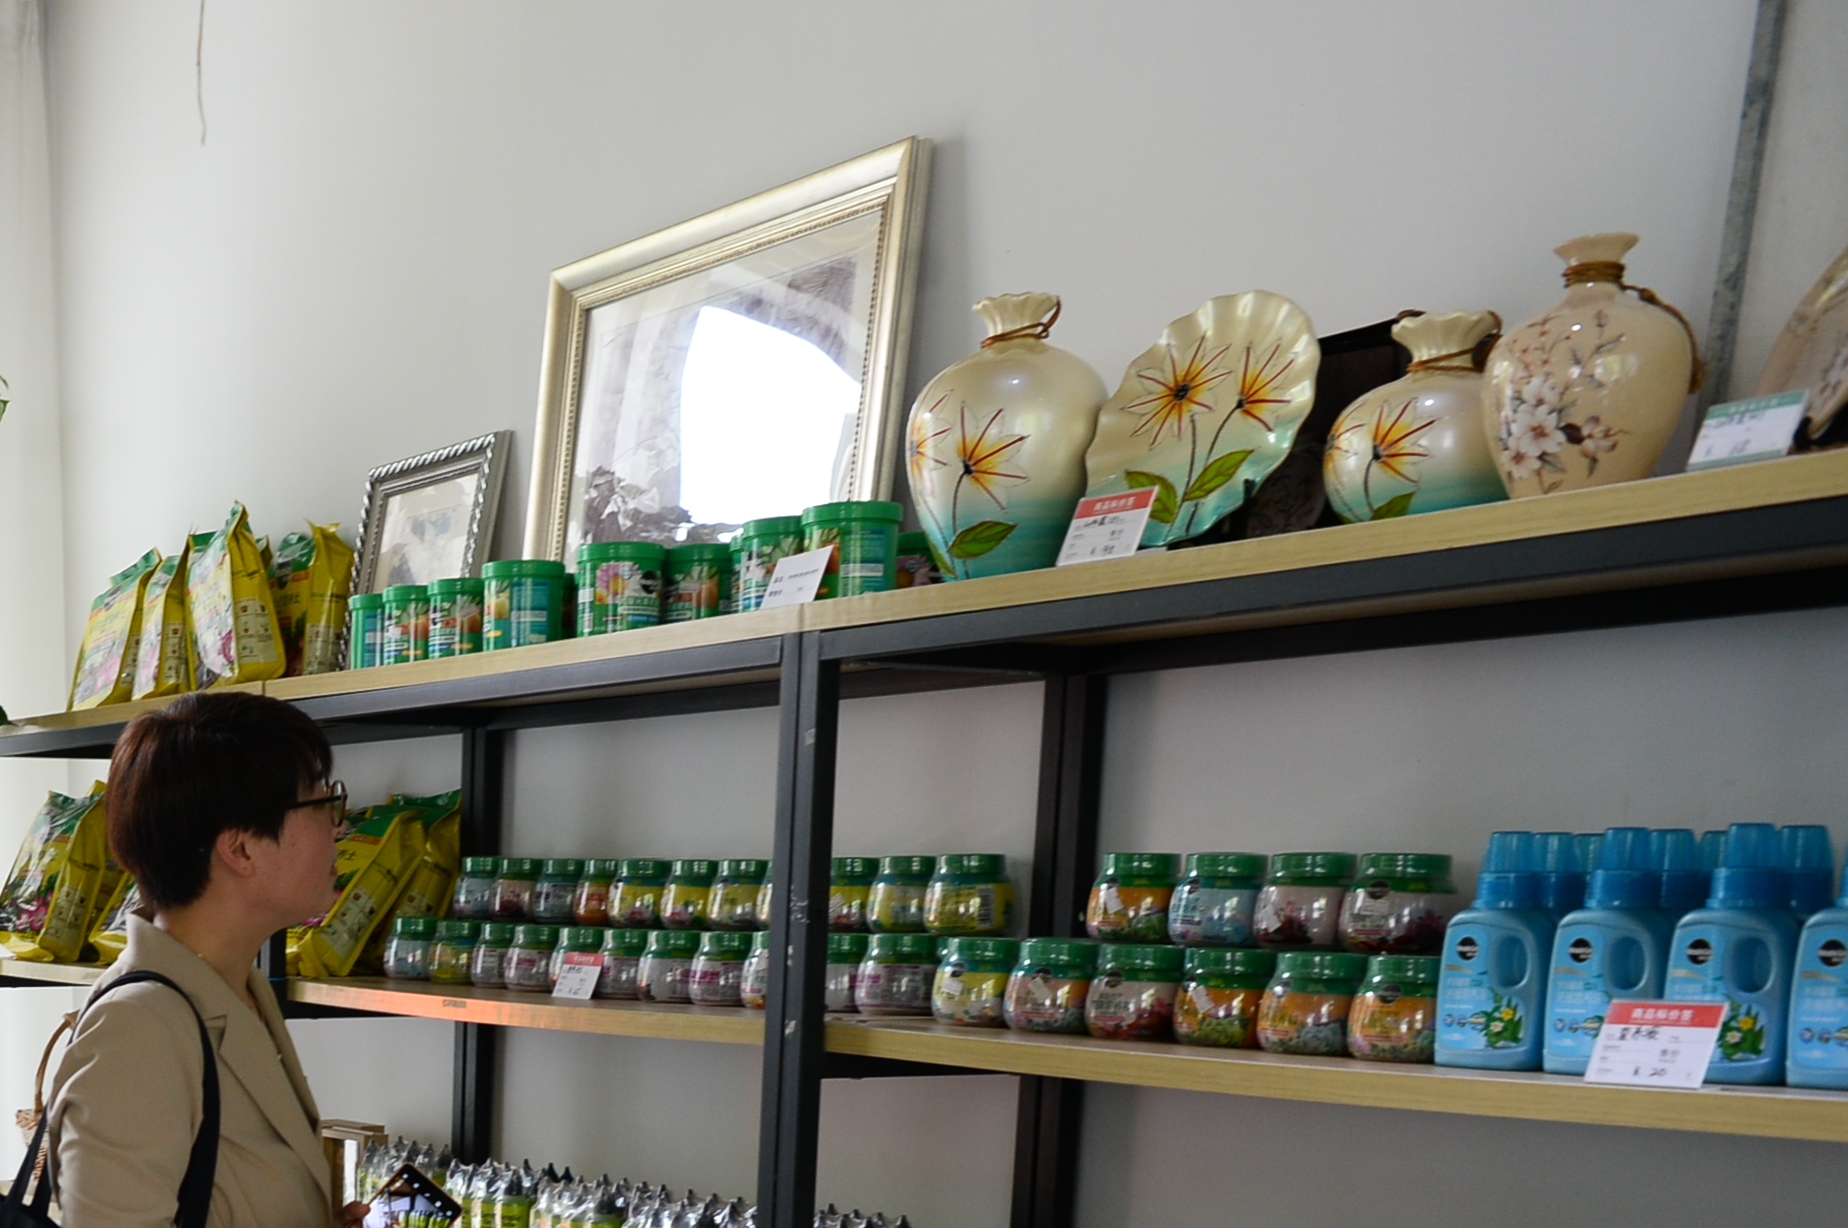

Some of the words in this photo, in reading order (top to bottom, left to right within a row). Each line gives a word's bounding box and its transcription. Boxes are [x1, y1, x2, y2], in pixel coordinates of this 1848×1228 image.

[1630, 1006, 1694, 1023] 商品标价签
